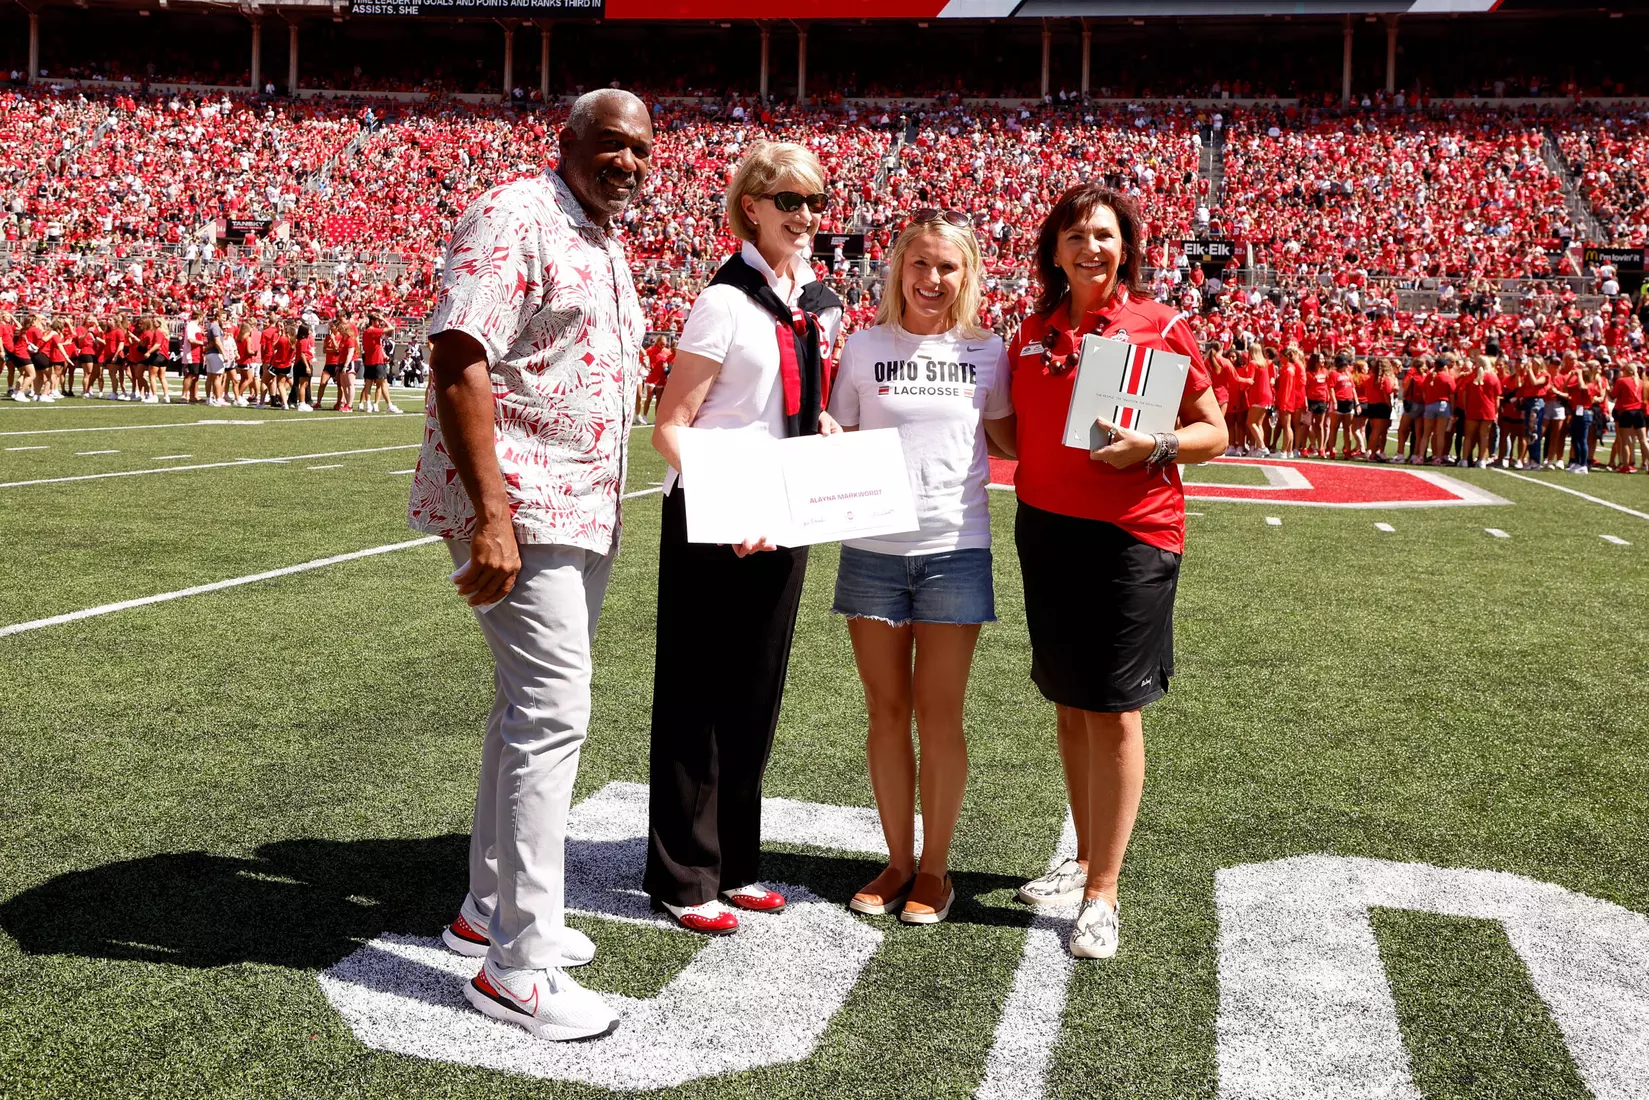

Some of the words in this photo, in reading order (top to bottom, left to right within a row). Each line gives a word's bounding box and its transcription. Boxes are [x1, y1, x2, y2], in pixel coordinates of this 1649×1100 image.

[352, 5, 396, 14] ASSISTS.
[398, 6, 420, 15] SHE
[1599, 253, 1611, 261] I'm
[1633, 253, 1640, 262] it
[874, 359, 918, 383] OHIO
[926, 360, 977, 384] STATE
[894, 385, 959, 397] LACROSSE
[809, 494, 836, 504] ALAYNA
[837, 489, 882, 501] MARKWORDT
